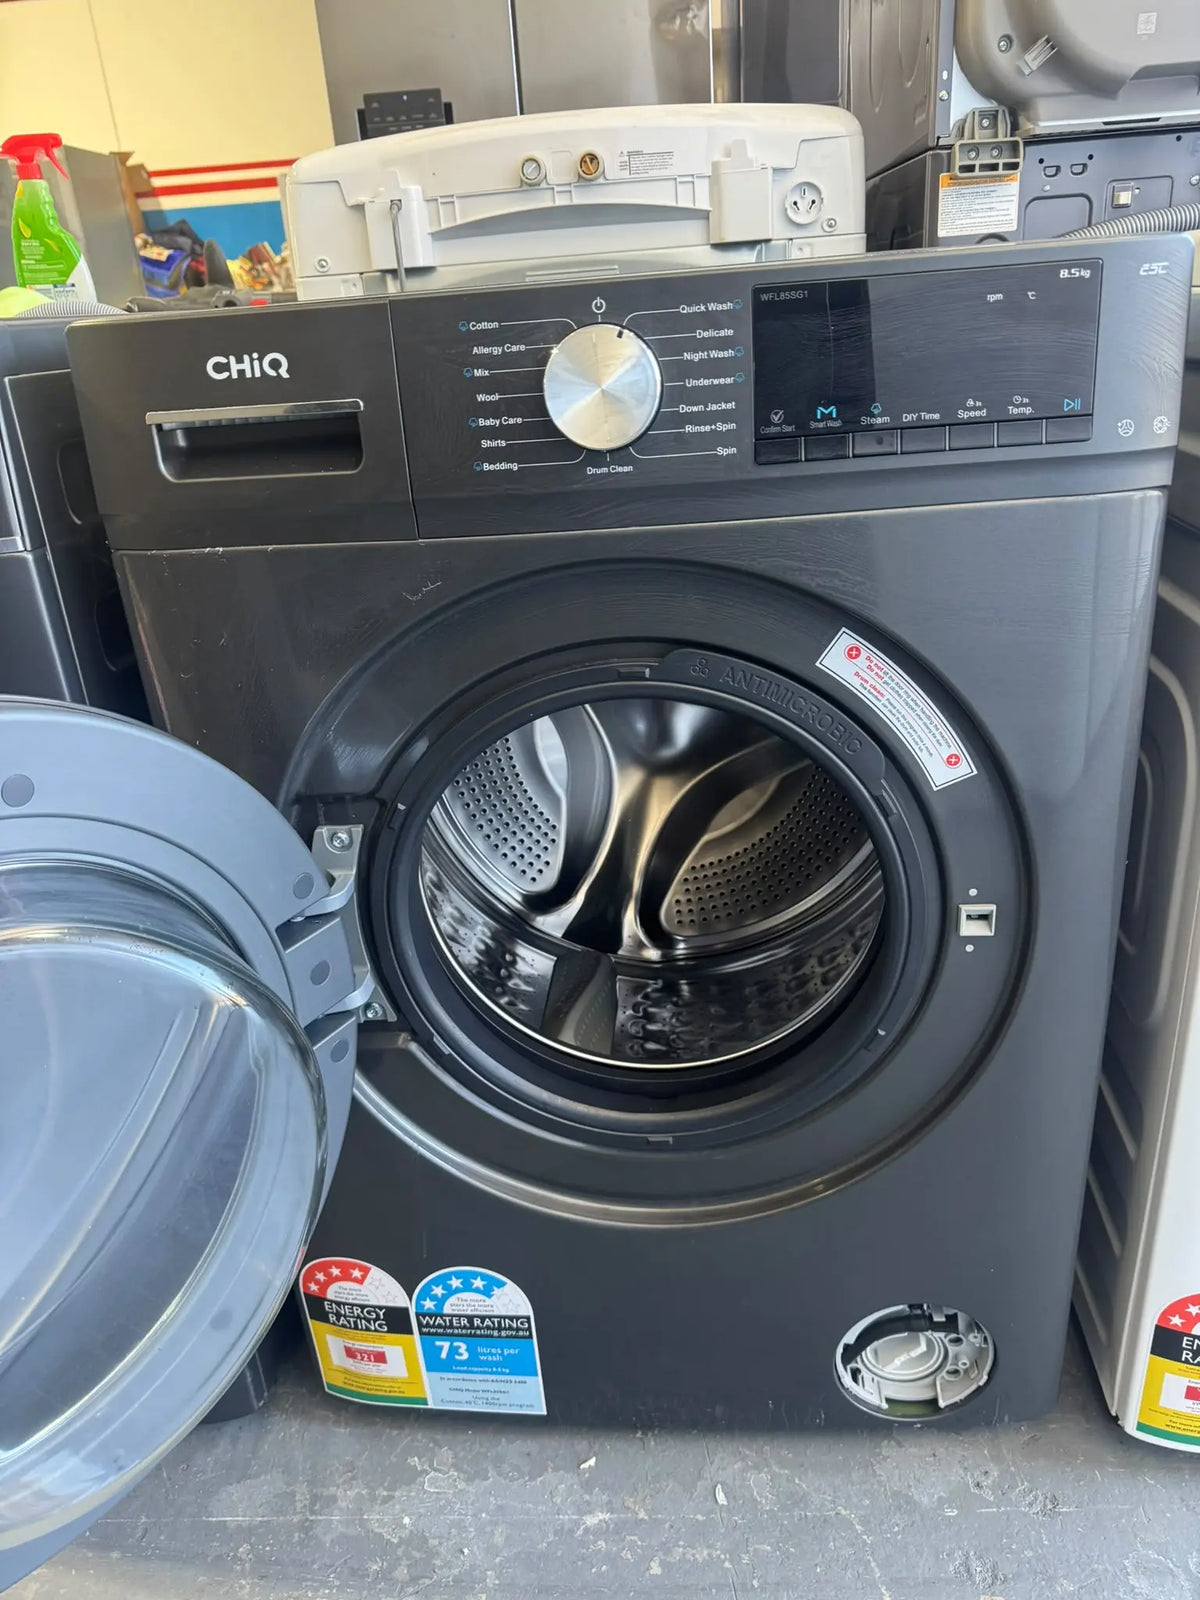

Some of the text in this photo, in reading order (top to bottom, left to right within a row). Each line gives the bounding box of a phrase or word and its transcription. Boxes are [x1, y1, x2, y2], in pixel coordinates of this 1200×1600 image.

[760, 291, 808, 301] WFL85SG1
[987, 292, 1003, 303] rpm
[679, 302, 733, 314] Quick Wash
[469, 321, 499, 331] Cotton
[696, 328, 734, 338] Delicate
[472, 344, 526, 355] Allergy Care
[683, 349, 734, 362] Night Wash
[206, 352, 290, 380] CHiQ
[473, 368, 490, 377] Mix
[685, 377, 735, 387] Underwear
[476, 393, 499, 402] Wool
[679, 402, 736, 413] Down Jacket
[1008, 406, 1035, 415] Temp.
[902, 411, 940, 422] DIY Time
[957, 408, 987, 419] Speed
[478, 416, 523, 427] Baby Care
[810, 420, 843, 429] Smart Wash
[860, 416, 890, 425] Steam
[685, 423, 736, 433] Rinse+Spin
[760, 424, 796, 434] Confirm Start
[481, 439, 506, 448] Shirts
[716, 447, 737, 456] Spin
[483, 462, 518, 471] Bedding
[586, 464, 633, 475] Drum Clean
[865, 655, 873, 664] Do
[873, 663, 884, 672] not
[854, 671, 869, 685] Drum
[866, 664, 874, 673] Do
[874, 671, 885, 681] not
[324, 1301, 386, 1319] ENERGY
[328, 1313, 388, 1332] RATING
[419, 1315, 529, 1329] WATER RATING
[421, 1326, 530, 1337] www.waterrating.gov.au
[434, 1340, 469, 1361] 73
[477, 1345, 520, 1356] litres per
[479, 1354, 503, 1362] wash
